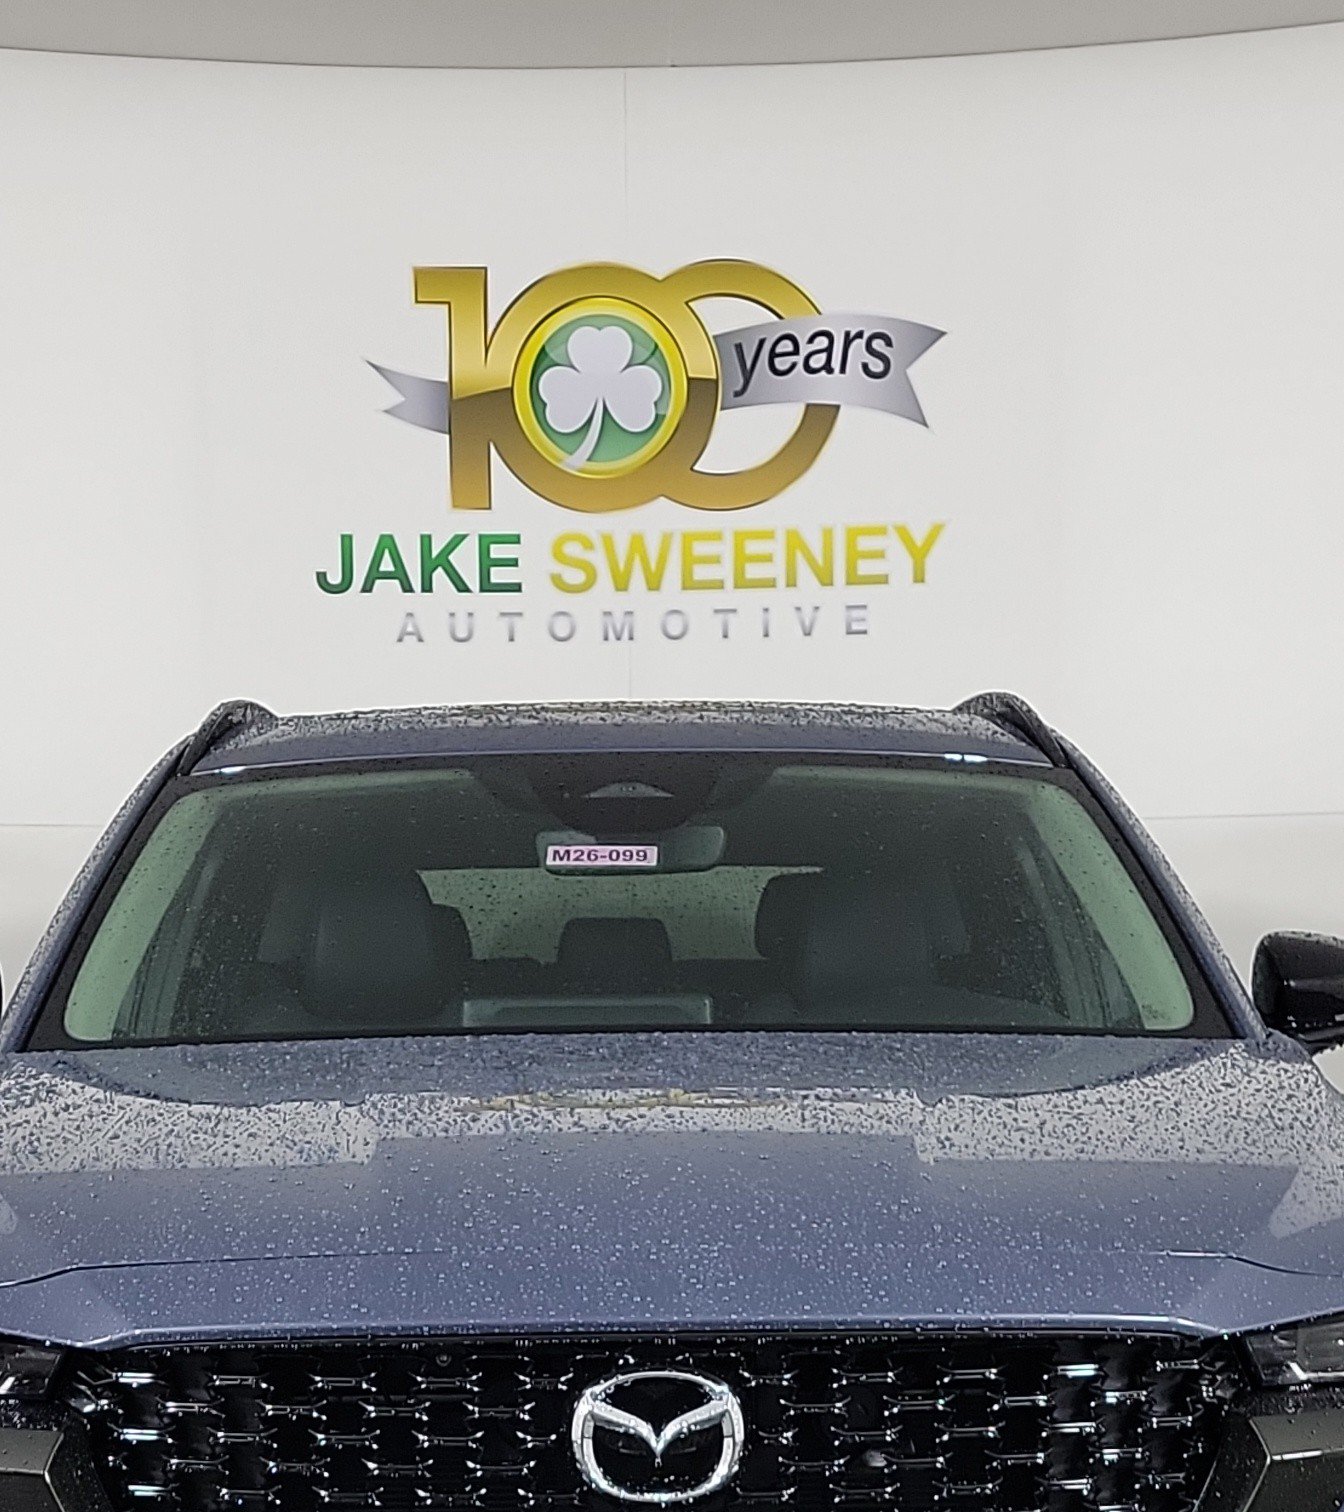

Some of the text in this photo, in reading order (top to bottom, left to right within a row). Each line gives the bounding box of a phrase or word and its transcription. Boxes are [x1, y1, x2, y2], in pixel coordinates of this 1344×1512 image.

[732, 328, 894, 398] years
[315, 522, 946, 594] JAKE SWEENEY
[396, 604, 870, 644] AUTOMOTIVE
[552, 849, 648, 862] M26-099
